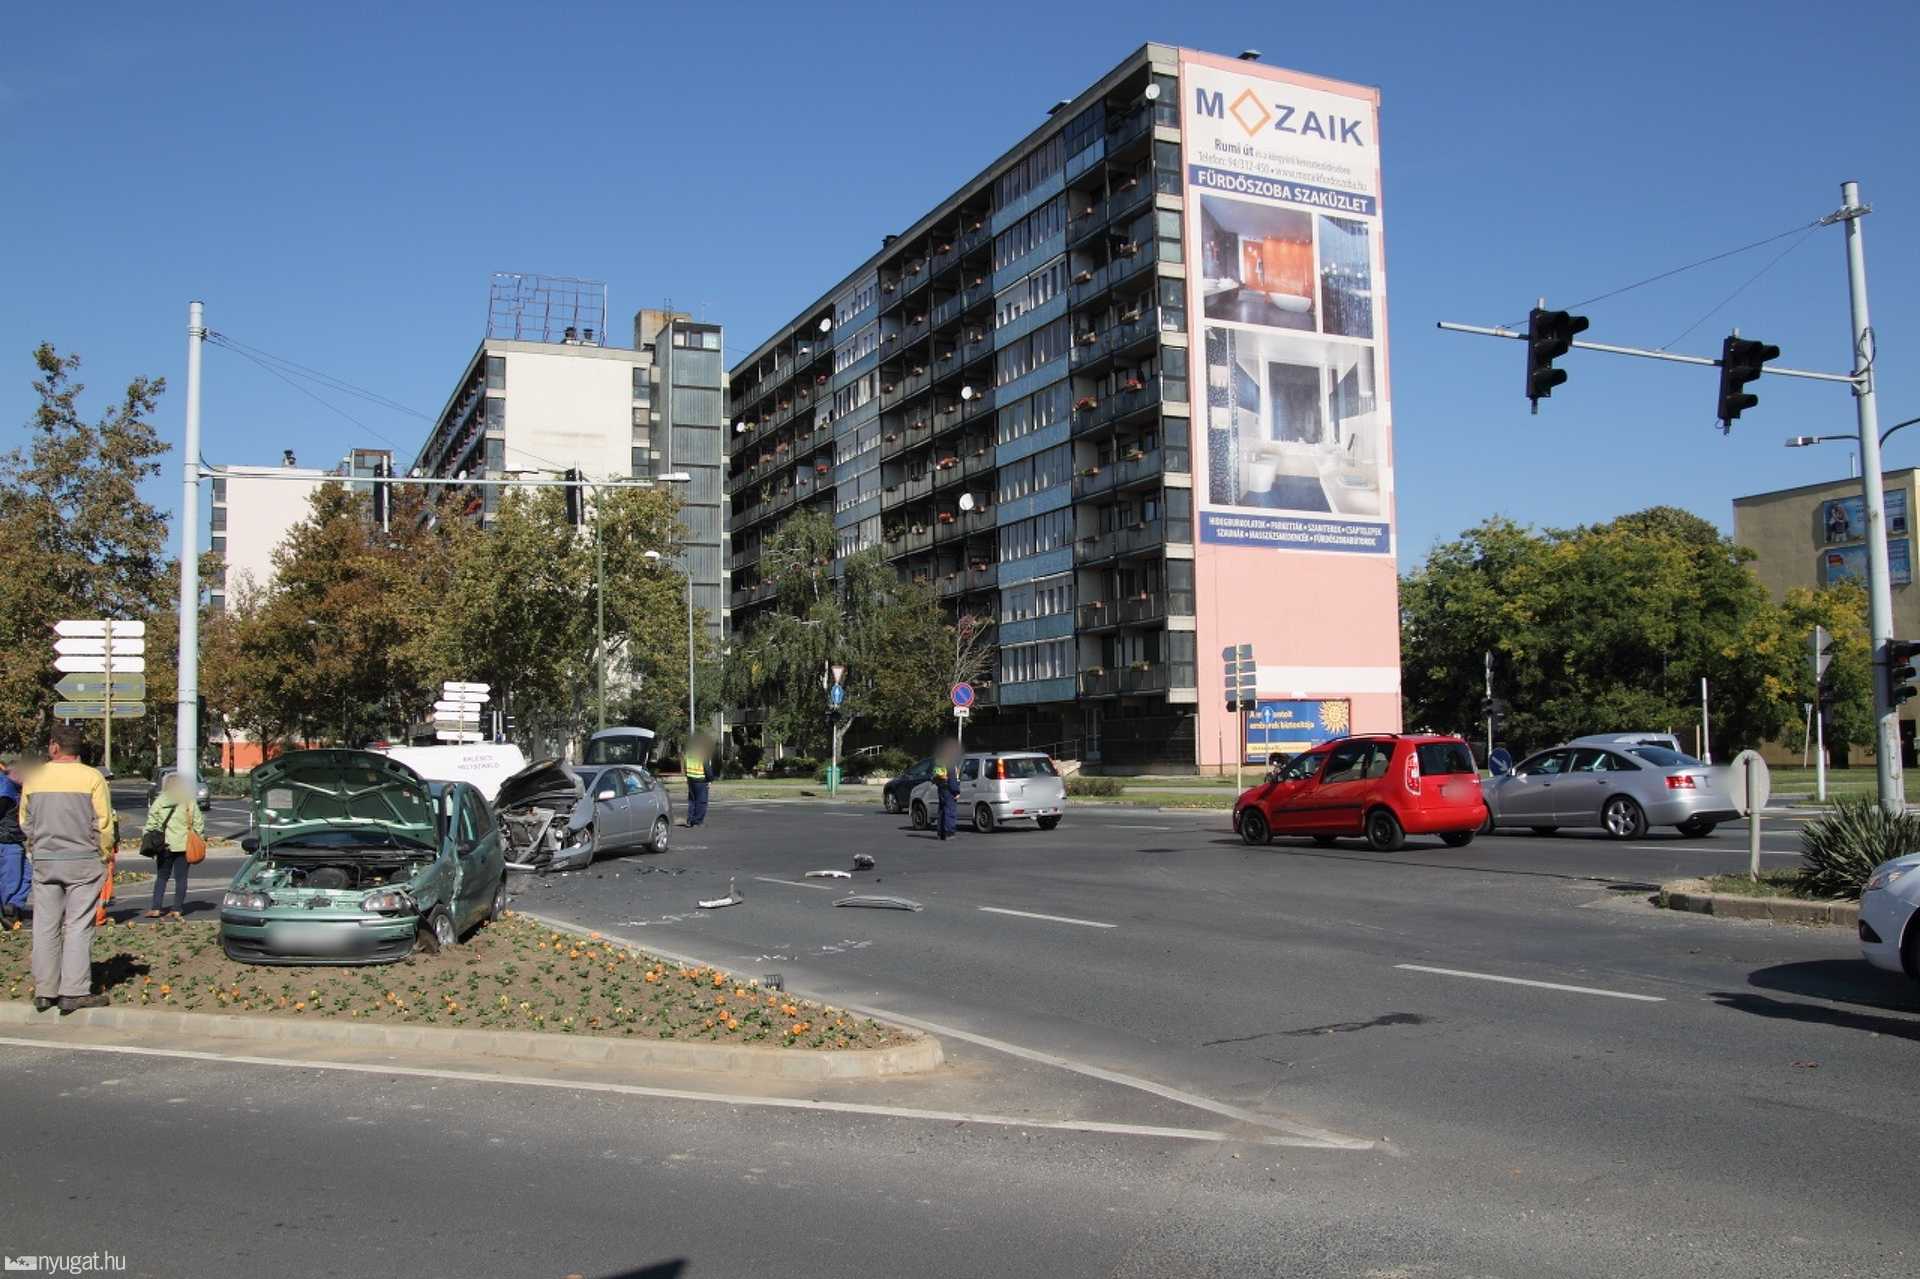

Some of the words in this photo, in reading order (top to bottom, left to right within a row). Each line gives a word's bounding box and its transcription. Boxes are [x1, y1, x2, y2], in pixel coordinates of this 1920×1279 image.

[1214, 138, 1241, 155] Rumi
[1243, 144, 1254, 157] út
[1198, 168, 1291, 199] FÜRDŐSZOBA
[1294, 186, 1368, 212] SZAKÜZLET
